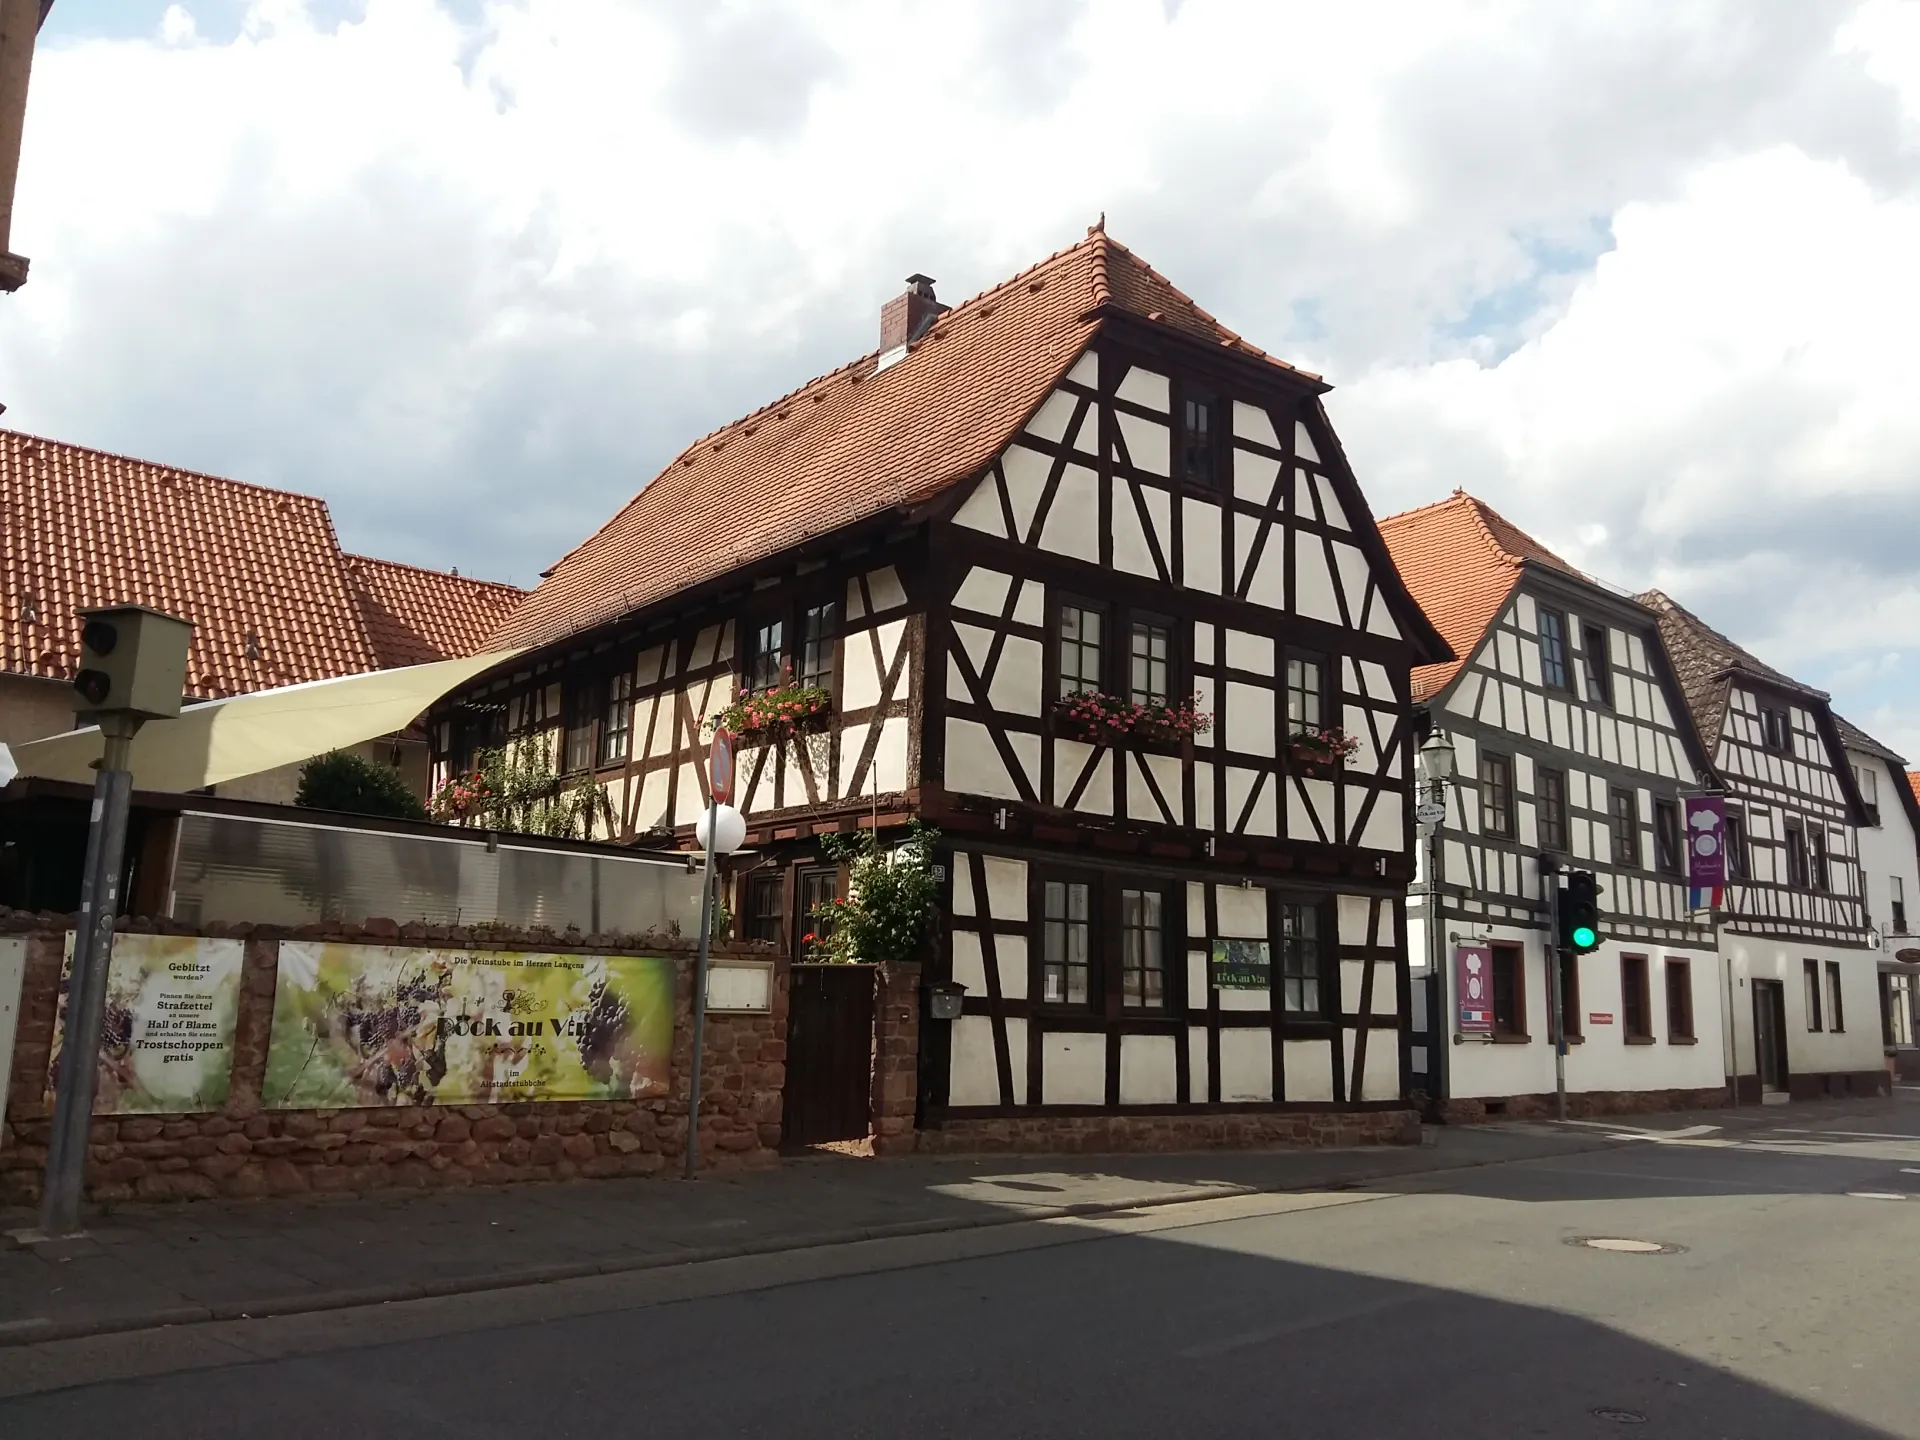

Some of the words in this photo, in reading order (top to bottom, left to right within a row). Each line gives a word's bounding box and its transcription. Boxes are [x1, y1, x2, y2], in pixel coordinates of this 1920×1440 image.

[168, 962, 211, 972] Geblitzt
[454, 957, 468, 965] Die
[470, 957, 511, 967] Weinstube
[513, 959, 524, 967] im
[526, 960, 552, 968] Herzen
[554, 961, 585, 970] Langens
[157, 1001, 213, 1011] Strafzettel
[147, 1020, 169, 1029] Hall
[172, 1020, 185, 1029] of
[185, 1020, 217, 1029] Blame
[508, 1021, 543, 1037] au
[550, 1016, 591, 1037] Vin
[136, 1039, 224, 1052] Trostschoppen
[163, 1053, 194, 1063] gratis
[509, 1069, 520, 1077] im
